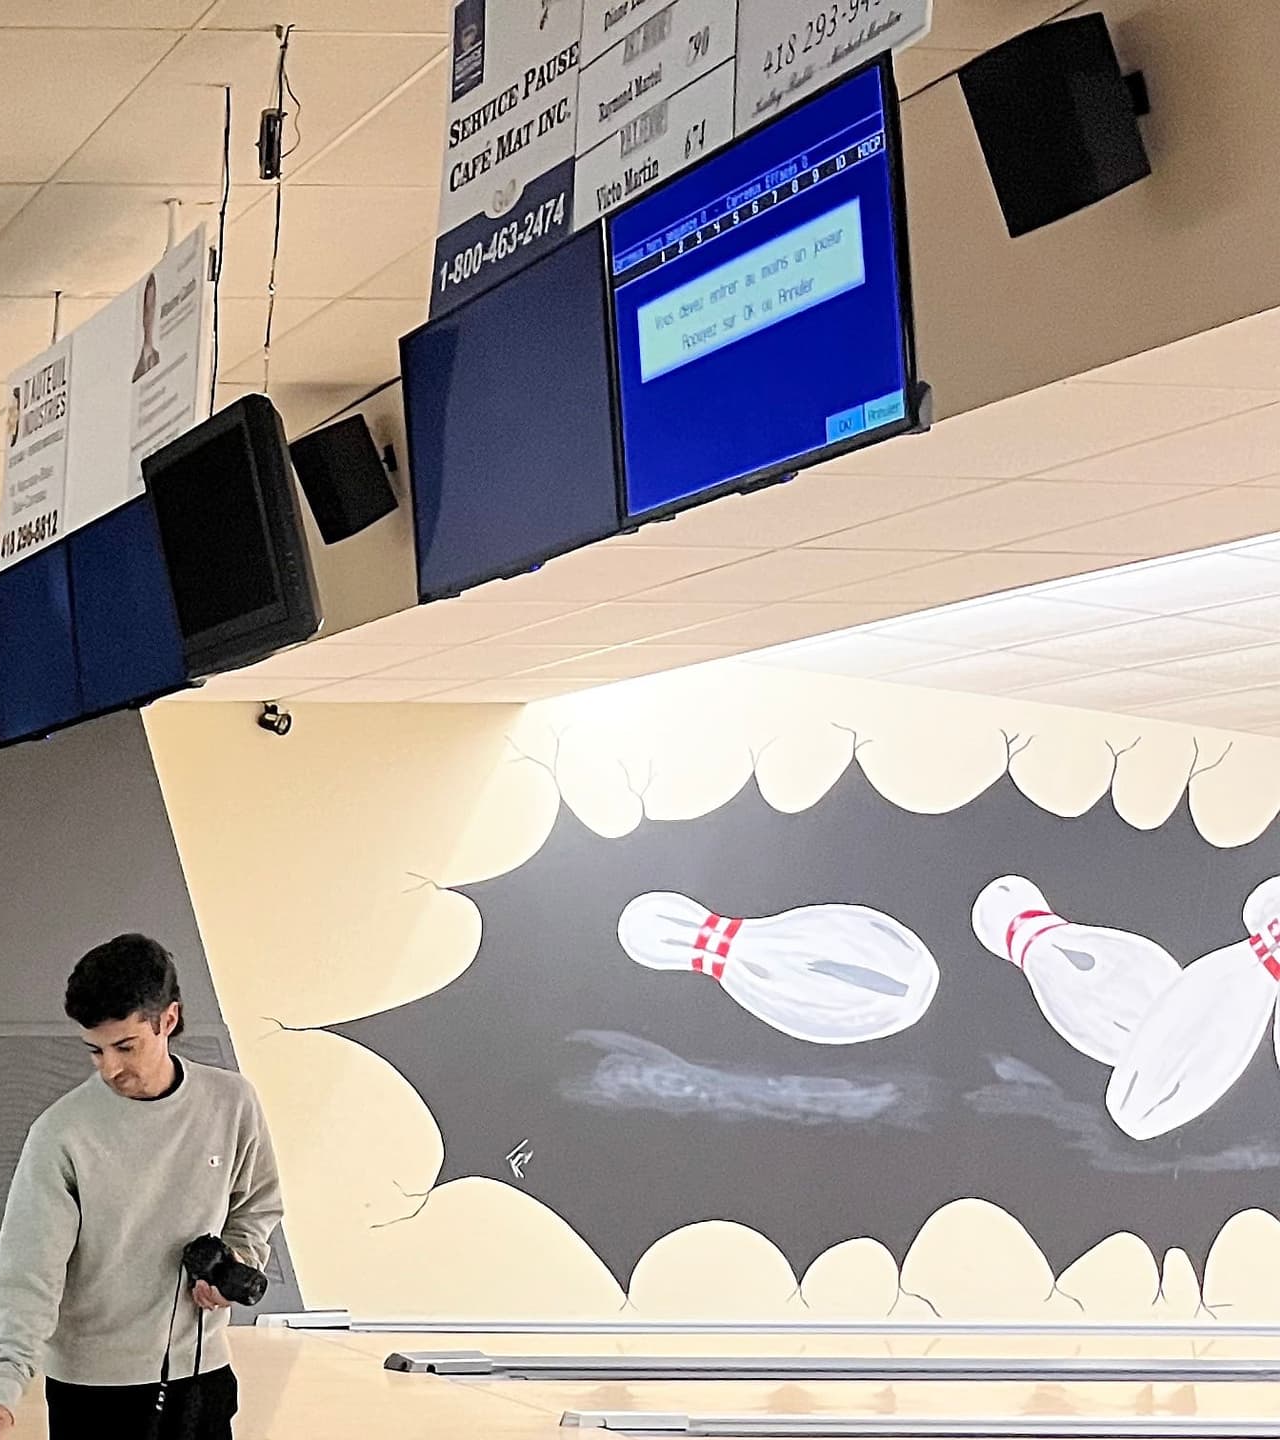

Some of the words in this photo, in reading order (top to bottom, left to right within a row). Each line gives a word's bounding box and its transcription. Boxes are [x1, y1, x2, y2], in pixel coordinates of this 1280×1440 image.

[449, 84, 519, 149] SERVICE
[522, 41, 580, 100] PAUSE
[763, 33, 797, 78] 418
[450, 140, 492, 192] CAFÉ
[495, 119, 535, 165] MAT
[537, 97, 572, 137] INC.
[624, 156, 659, 196] Martin
[441, 192, 565, 292] 1-800-463-2474
[661, 250, 666, 263] 1
[678, 240, 684, 254] 2
[695, 231, 702, 245] 3
[713, 221, 721, 234] 4
[732, 211, 740, 225] 5
[751, 200, 759, 214] 6
[771, 190, 778, 204] 7
[811, 168, 820, 184] 9
[835, 154, 846, 171] 10
[761, 256, 789, 279] moins
